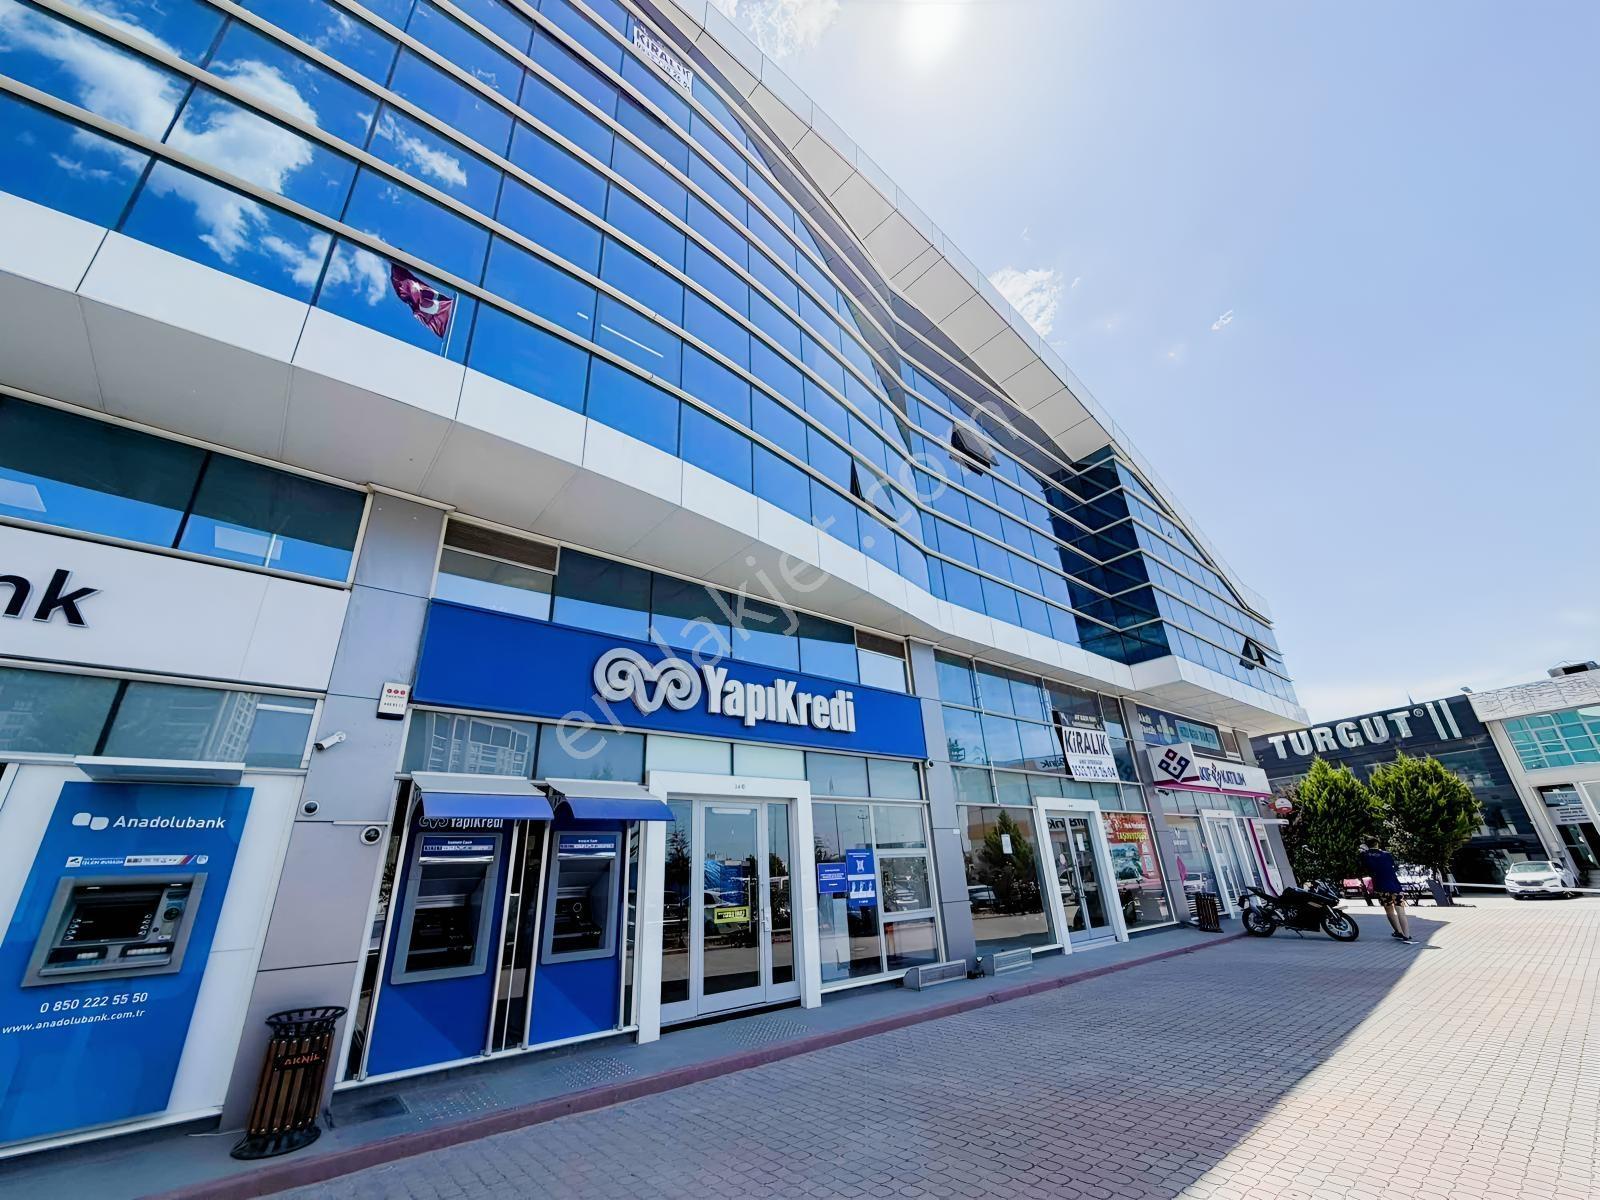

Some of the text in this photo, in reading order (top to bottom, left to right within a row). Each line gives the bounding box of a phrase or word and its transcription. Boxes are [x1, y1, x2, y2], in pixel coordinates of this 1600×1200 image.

[113, 814, 225, 830] Anadolubank
[40, 992, 148, 1014] 0 850 222 55 50
[2, 1009, 146, 1034] www.anadolubank.com.tr
